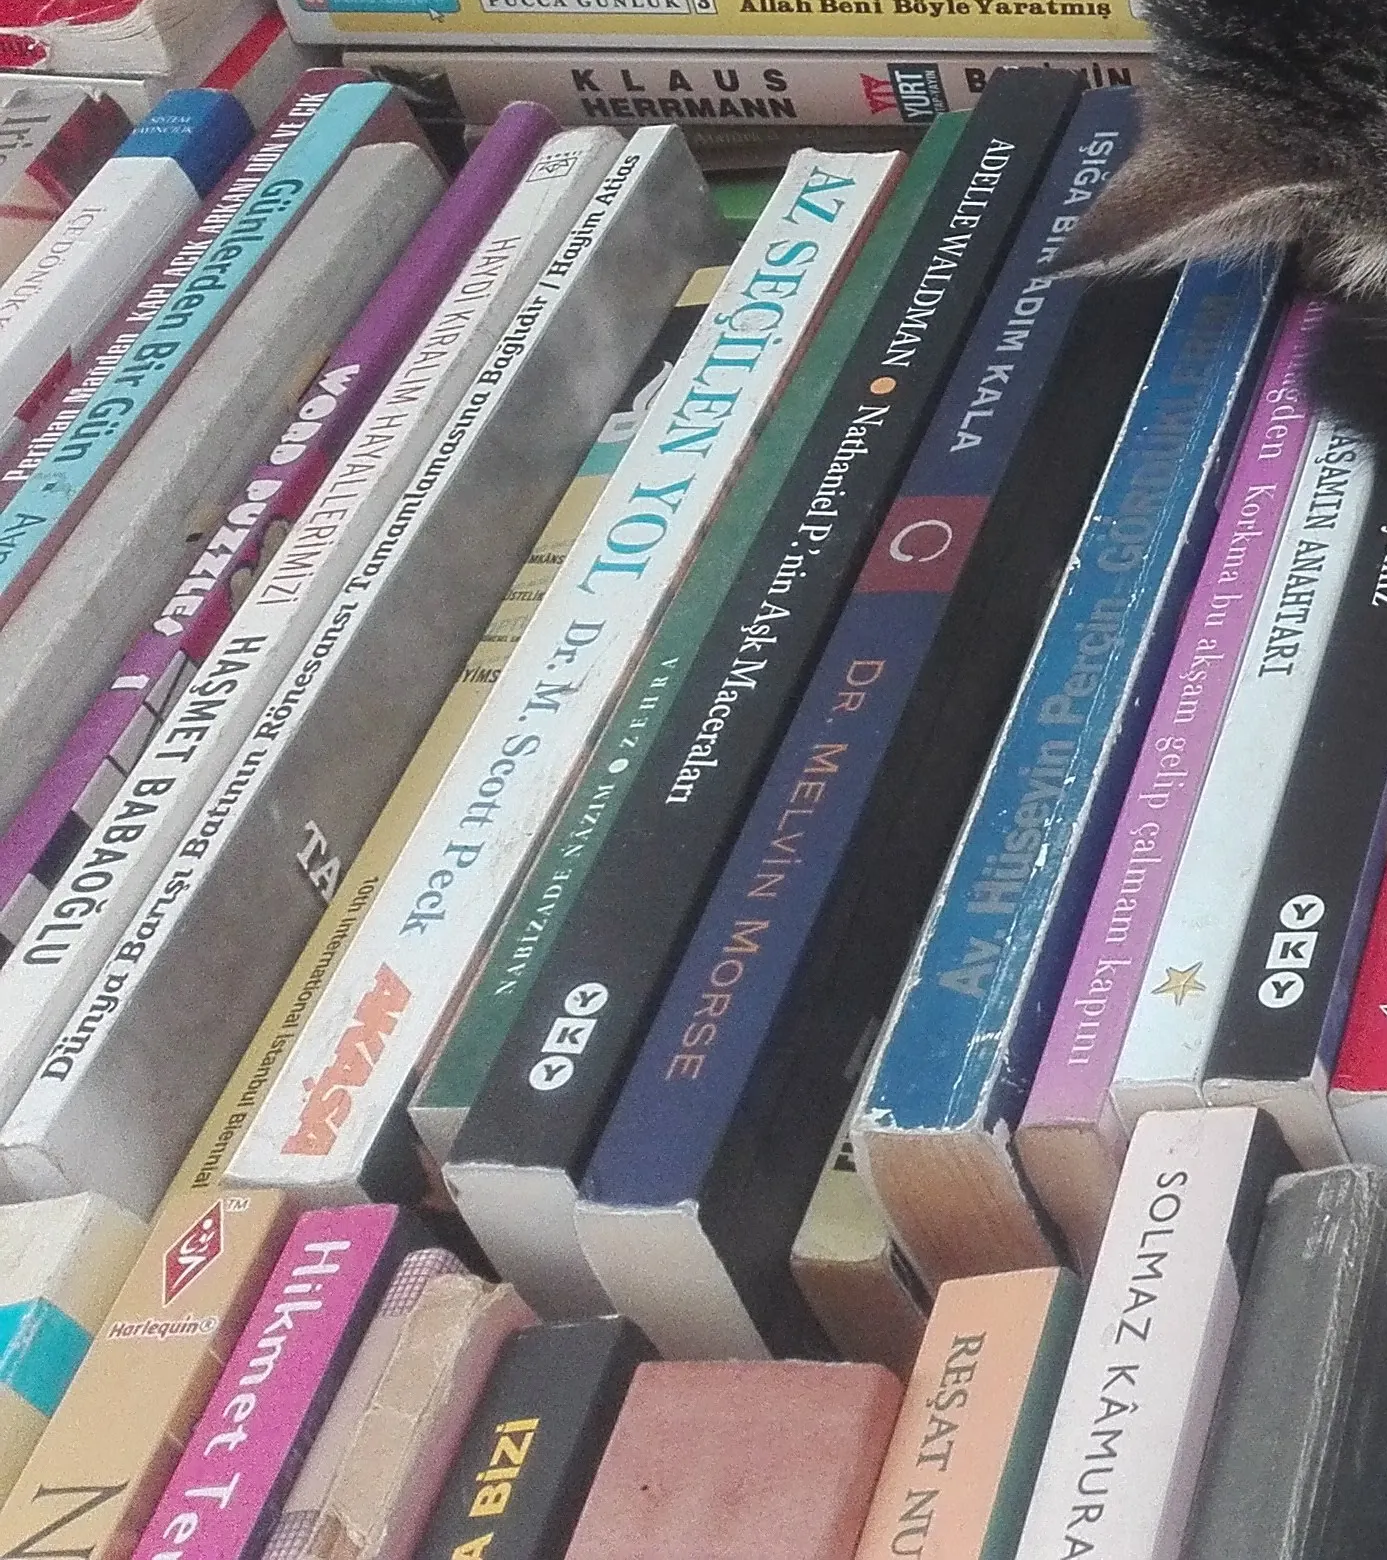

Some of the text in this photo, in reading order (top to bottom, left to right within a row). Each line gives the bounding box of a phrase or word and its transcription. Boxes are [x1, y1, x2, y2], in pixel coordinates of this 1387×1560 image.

[581, 96, 797, 119] HERRMANN
[895, 70, 932, 118] YURT
[782, 165, 856, 224] AZ
[2, 411, 78, 482] Perihan
[63, 333, 139, 414] Mağden
[126, 278, 173, 322] KAPI
[197, 171, 260, 235] ARKANI
[247, 133, 288, 178] DÖN
[275, 109, 309, 138] VE
[53, 178, 303, 464] Günlerden Bir Gün
[657, 238, 820, 457] SEÇİLEN
[998, 272, 1053, 353] ADIM
[270, 363, 360, 466] WORD
[665, 137, 1017, 806] ADELLE WALDMAN Nathaniel Aşk Maceraları
[949, 362, 1016, 455] KALA
[22, 236, 521, 967] HAYDİ KIRALIM HAYALLERİMİZİ HAŞMET BABAOĞLU
[577, 472, 697, 596] YOL
[41, 969, 126, 1083] Dünya
[119, 869, 195, 965] Barışı
[187, 747, 268, 860] Batının
[259, 594, 359, 740] Rönesansı
[344, 391, 490, 594] Tamamlamasına
[479, 295, 550, 386] Bağlıdır
[548, 213, 605, 282] Hayim
[598, 151, 641, 219] Atias
[546, 618, 607, 677] Dr.
[1258, 538, 1329, 680] ANAHTARI
[518, 679, 570, 728] M.
[1067, 482, 1276, 1067] Korkma bu akşam gelip çalmam kapını
[457, 732, 541, 830] Scott
[495, 652, 682, 997] NABİZADE ZEHRA
[967, 737, 1078, 916] Hüseyin
[398, 841, 483, 937] Peck
[663, 739, 850, 1081] MELVİN MORSE
[282, 913, 361, 1030] International
[1115, 1169, 1189, 1343] SOLMAZ
[203, 1239, 353, 1457] Hikmet
[914, 1329, 988, 1472] REŞAT
